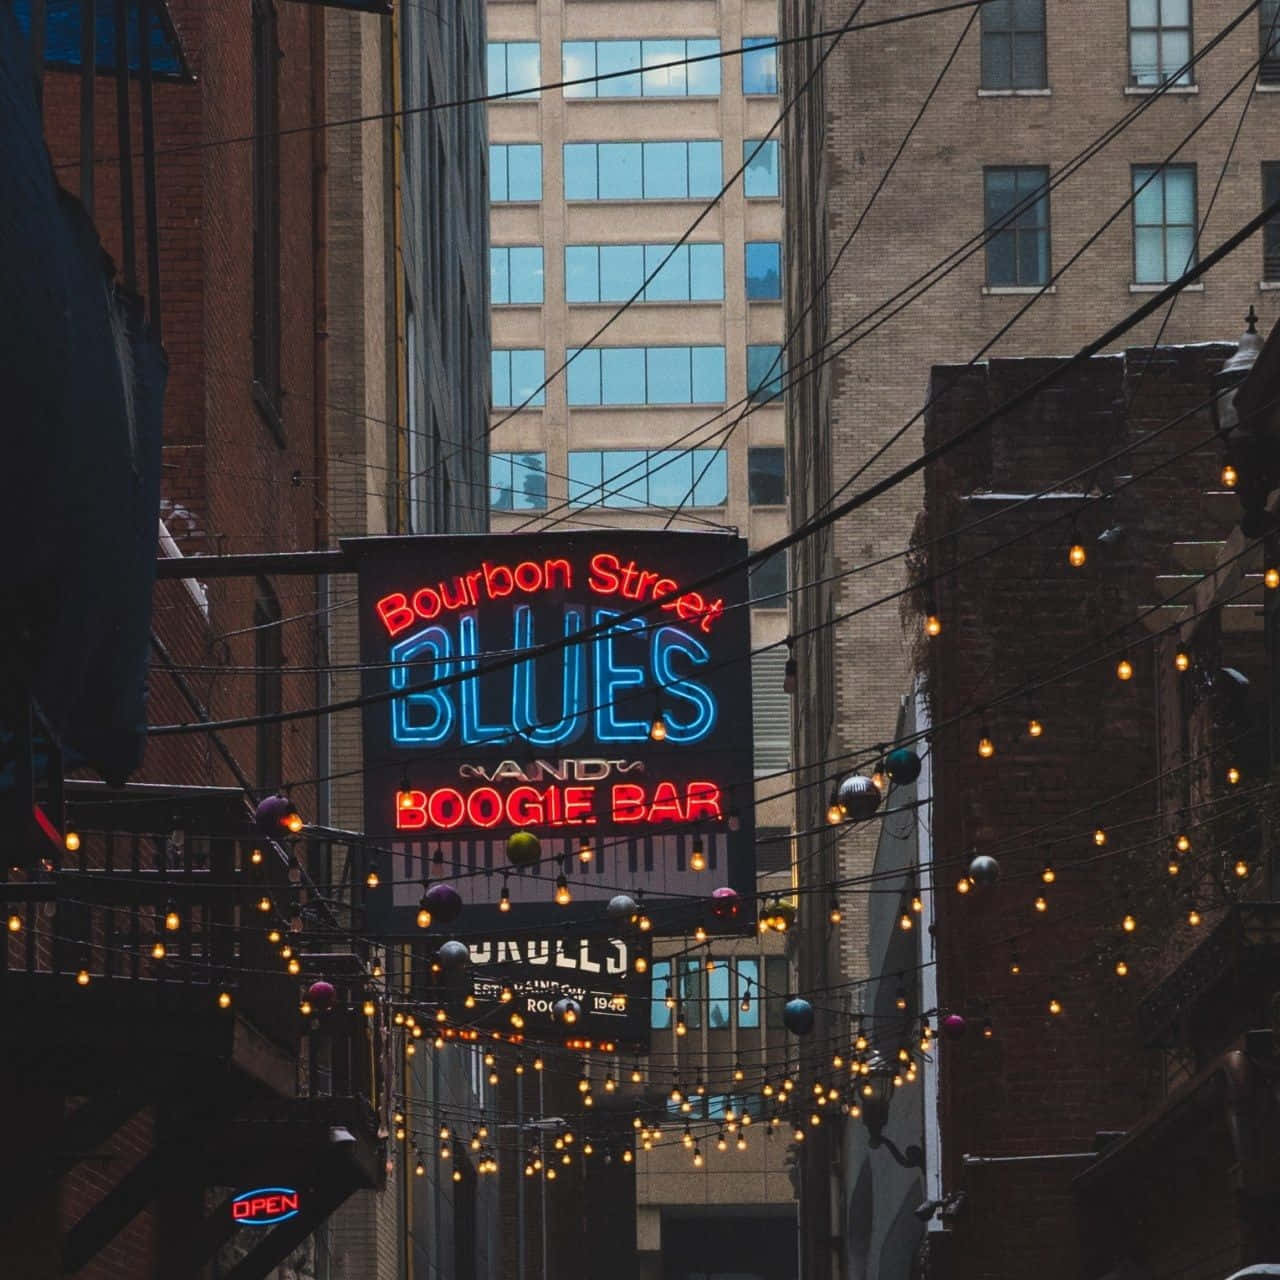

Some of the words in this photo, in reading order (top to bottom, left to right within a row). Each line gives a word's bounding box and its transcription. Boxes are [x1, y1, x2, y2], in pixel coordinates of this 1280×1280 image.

[376, 557, 573, 638] Bourbon
[587, 552, 724, 633] Street
[390, 604, 717, 746] BLUES
[490, 760, 611, 782] AND
[395, 785, 597, 831] BOOGIE
[611, 782, 723, 824] BAR
[233, 1194, 298, 1218] OPEN
